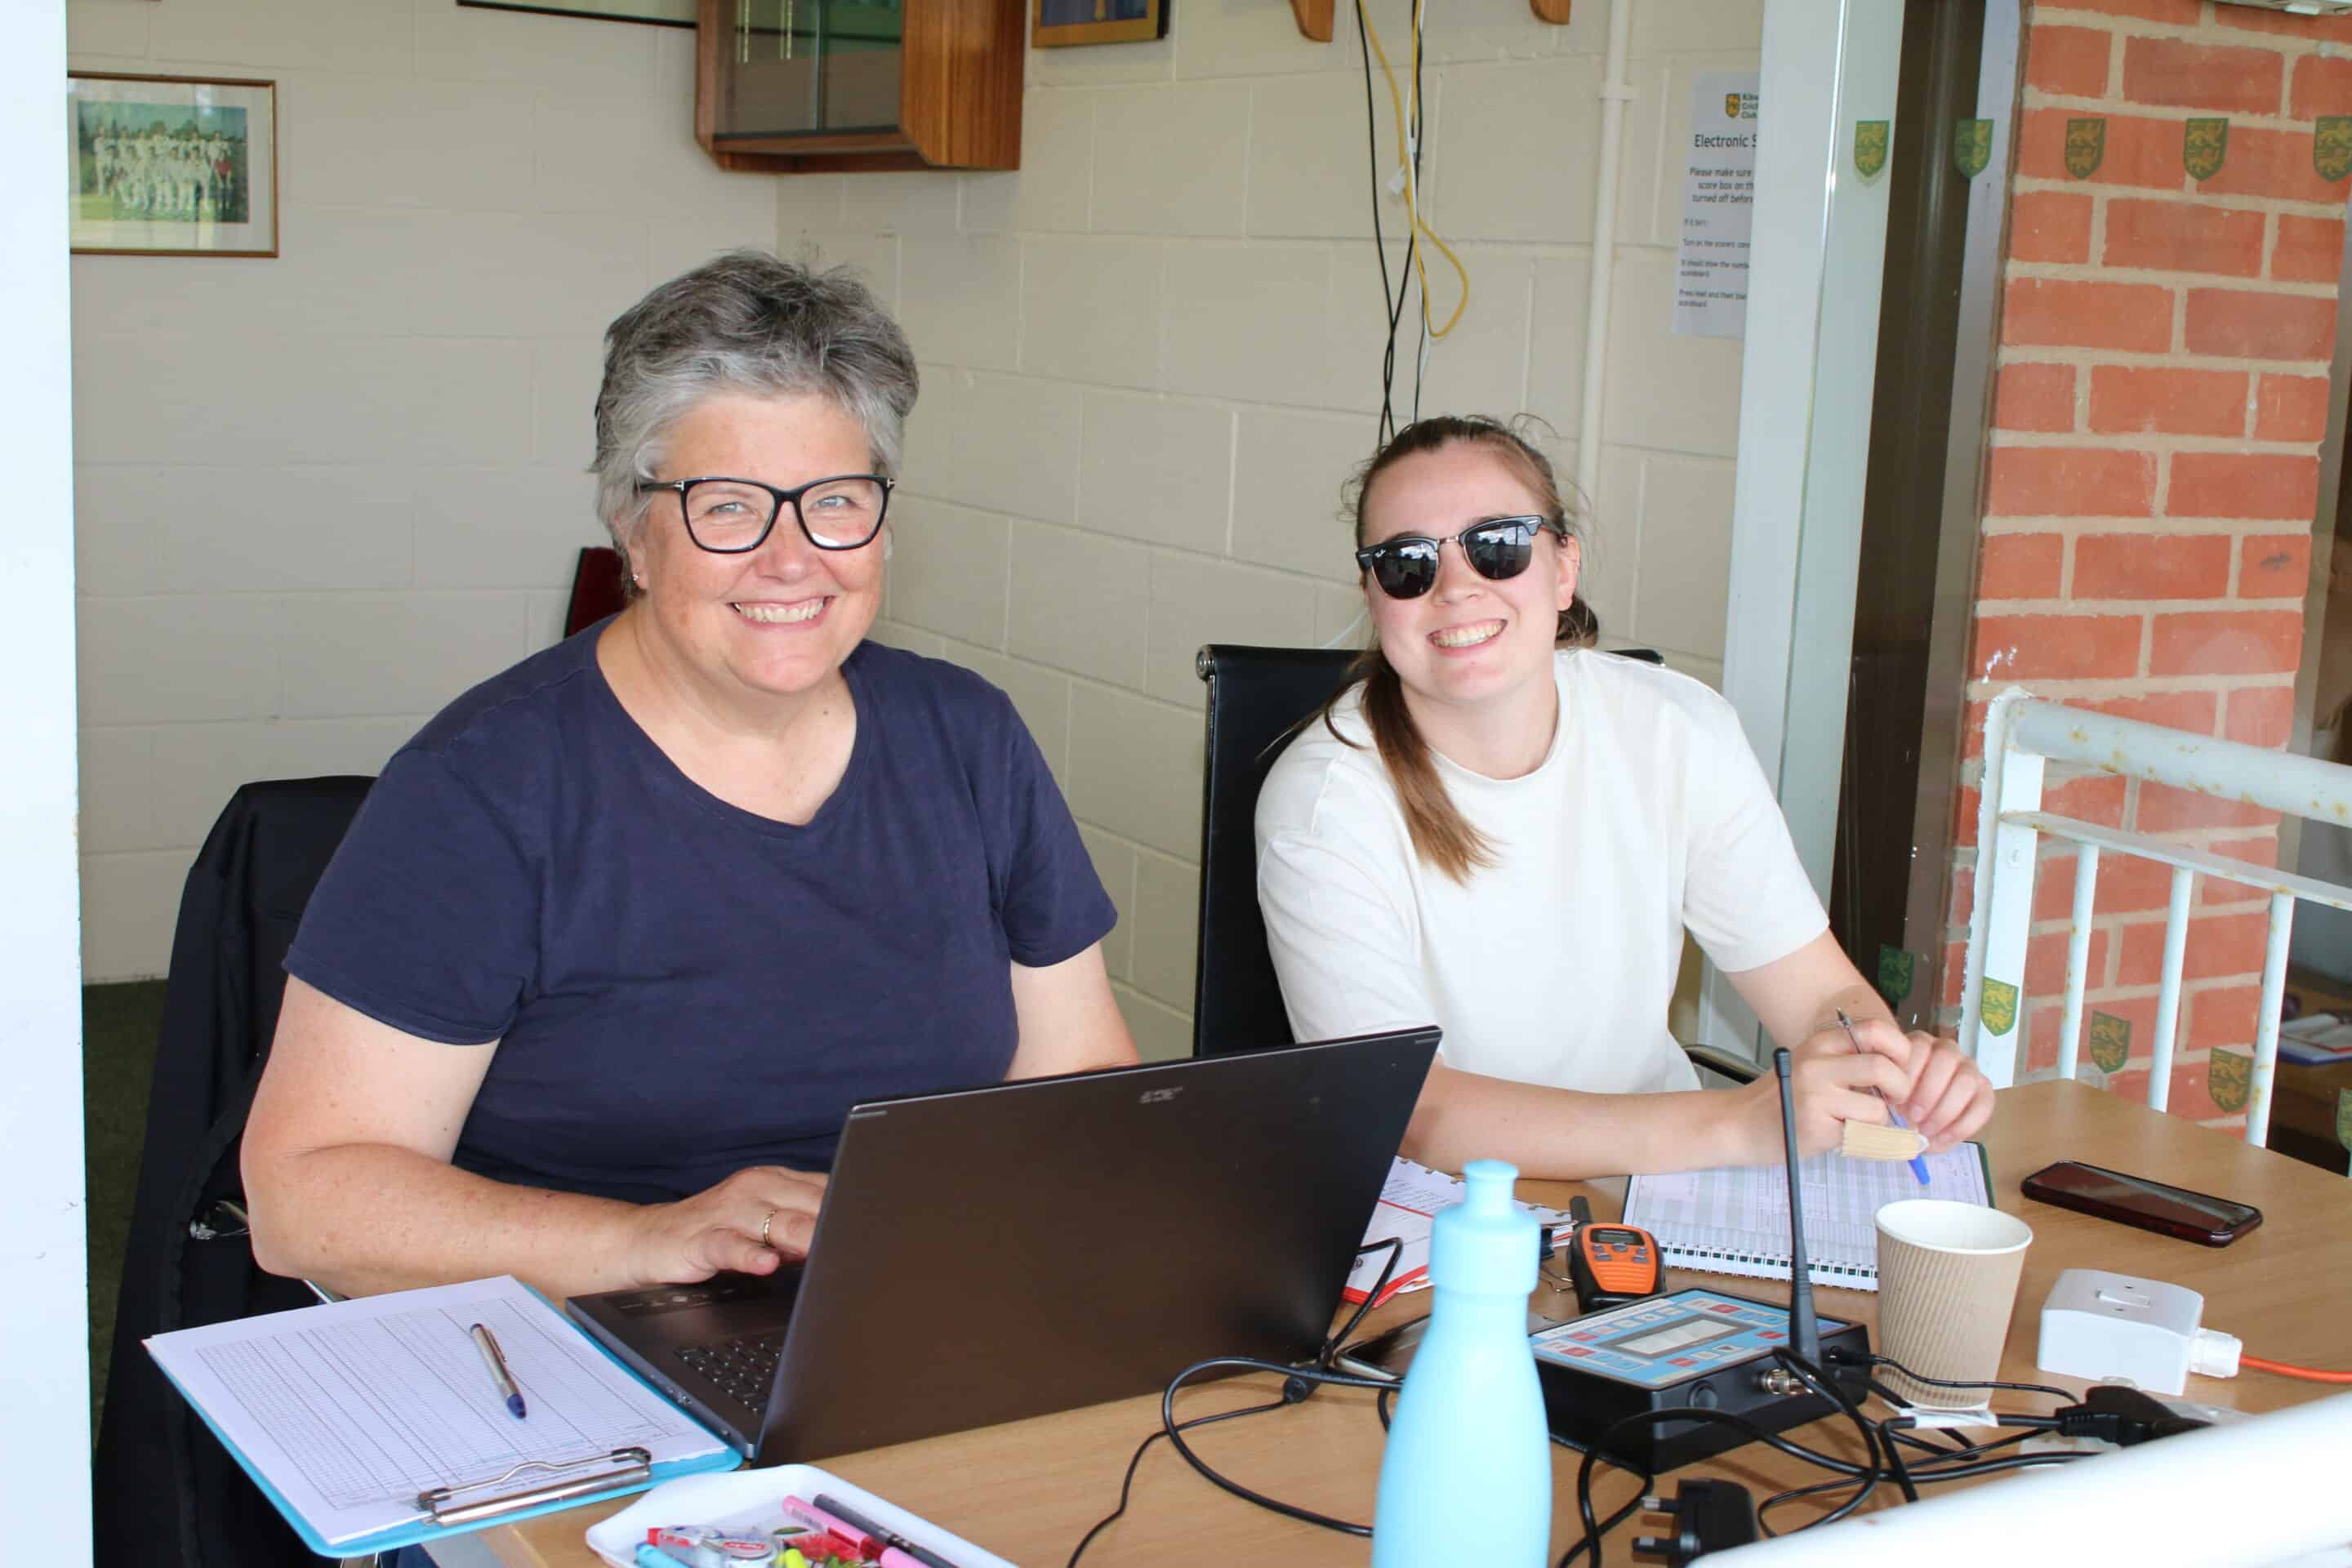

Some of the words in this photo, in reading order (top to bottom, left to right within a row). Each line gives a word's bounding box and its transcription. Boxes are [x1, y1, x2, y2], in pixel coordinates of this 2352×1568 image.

[1694, 134, 1748, 148] Electronic
[1689, 167, 1713, 177] Please
[1714, 166, 1734, 177] make
[1736, 169, 1752, 177] sure
[1698, 182, 1717, 190] score
[1719, 179, 1732, 190] box
[1734, 182, 1744, 190] on
[1692, 194, 1717, 203] turned
[1718, 193, 1729, 203] off
